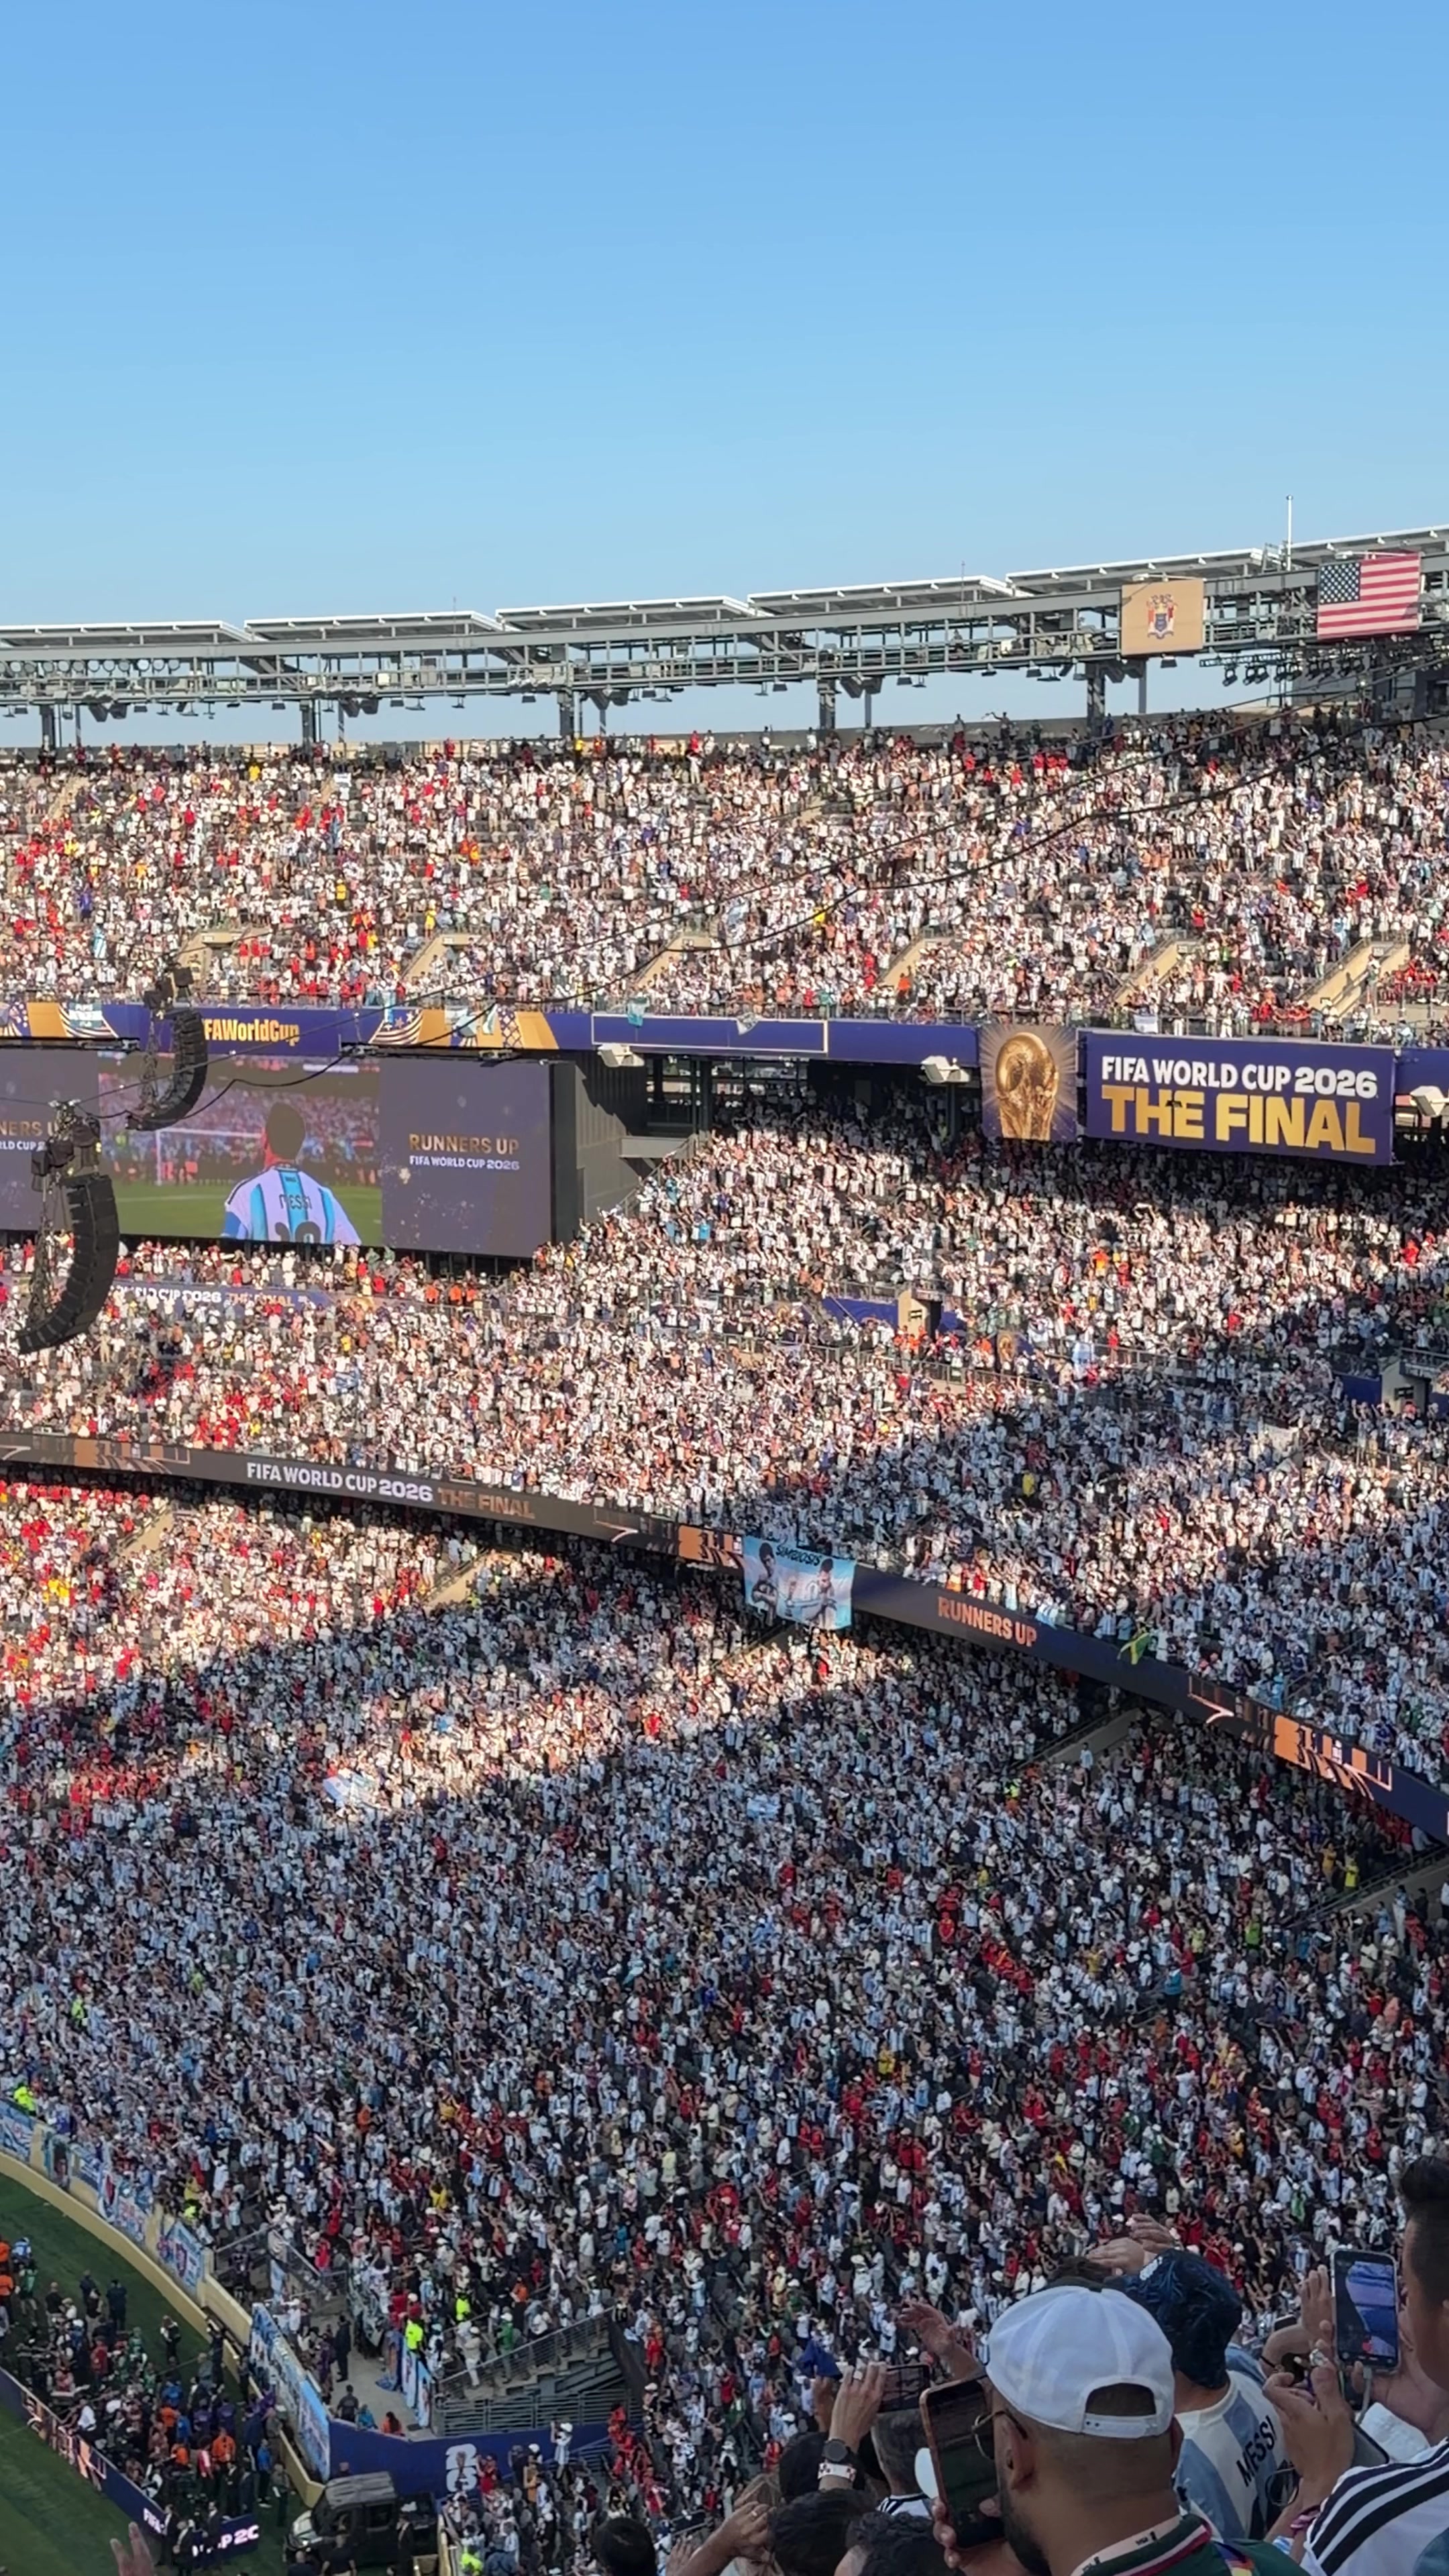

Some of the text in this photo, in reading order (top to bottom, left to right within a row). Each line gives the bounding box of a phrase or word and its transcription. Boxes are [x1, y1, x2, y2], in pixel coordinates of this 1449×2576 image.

[202, 1018, 300, 1046] FAWorldCup
[1102, 1055, 1378, 1099] FIFA WORLD CUP 2026
[1102, 1085, 1376, 1154] THE FINAL
[17, 1140, 37, 1151] CUP
[409, 1134, 520, 1155] RUNNERS UP
[409, 1155, 519, 1171] FIFA WORLD CUP 2026
[247, 1462, 535, 1519] FIFA WORLD CUP 2026 THE FINAL
[938, 1596, 1037, 1648] RUNNERS UP
[1236, 2414, 1277, 2487] MESSI
